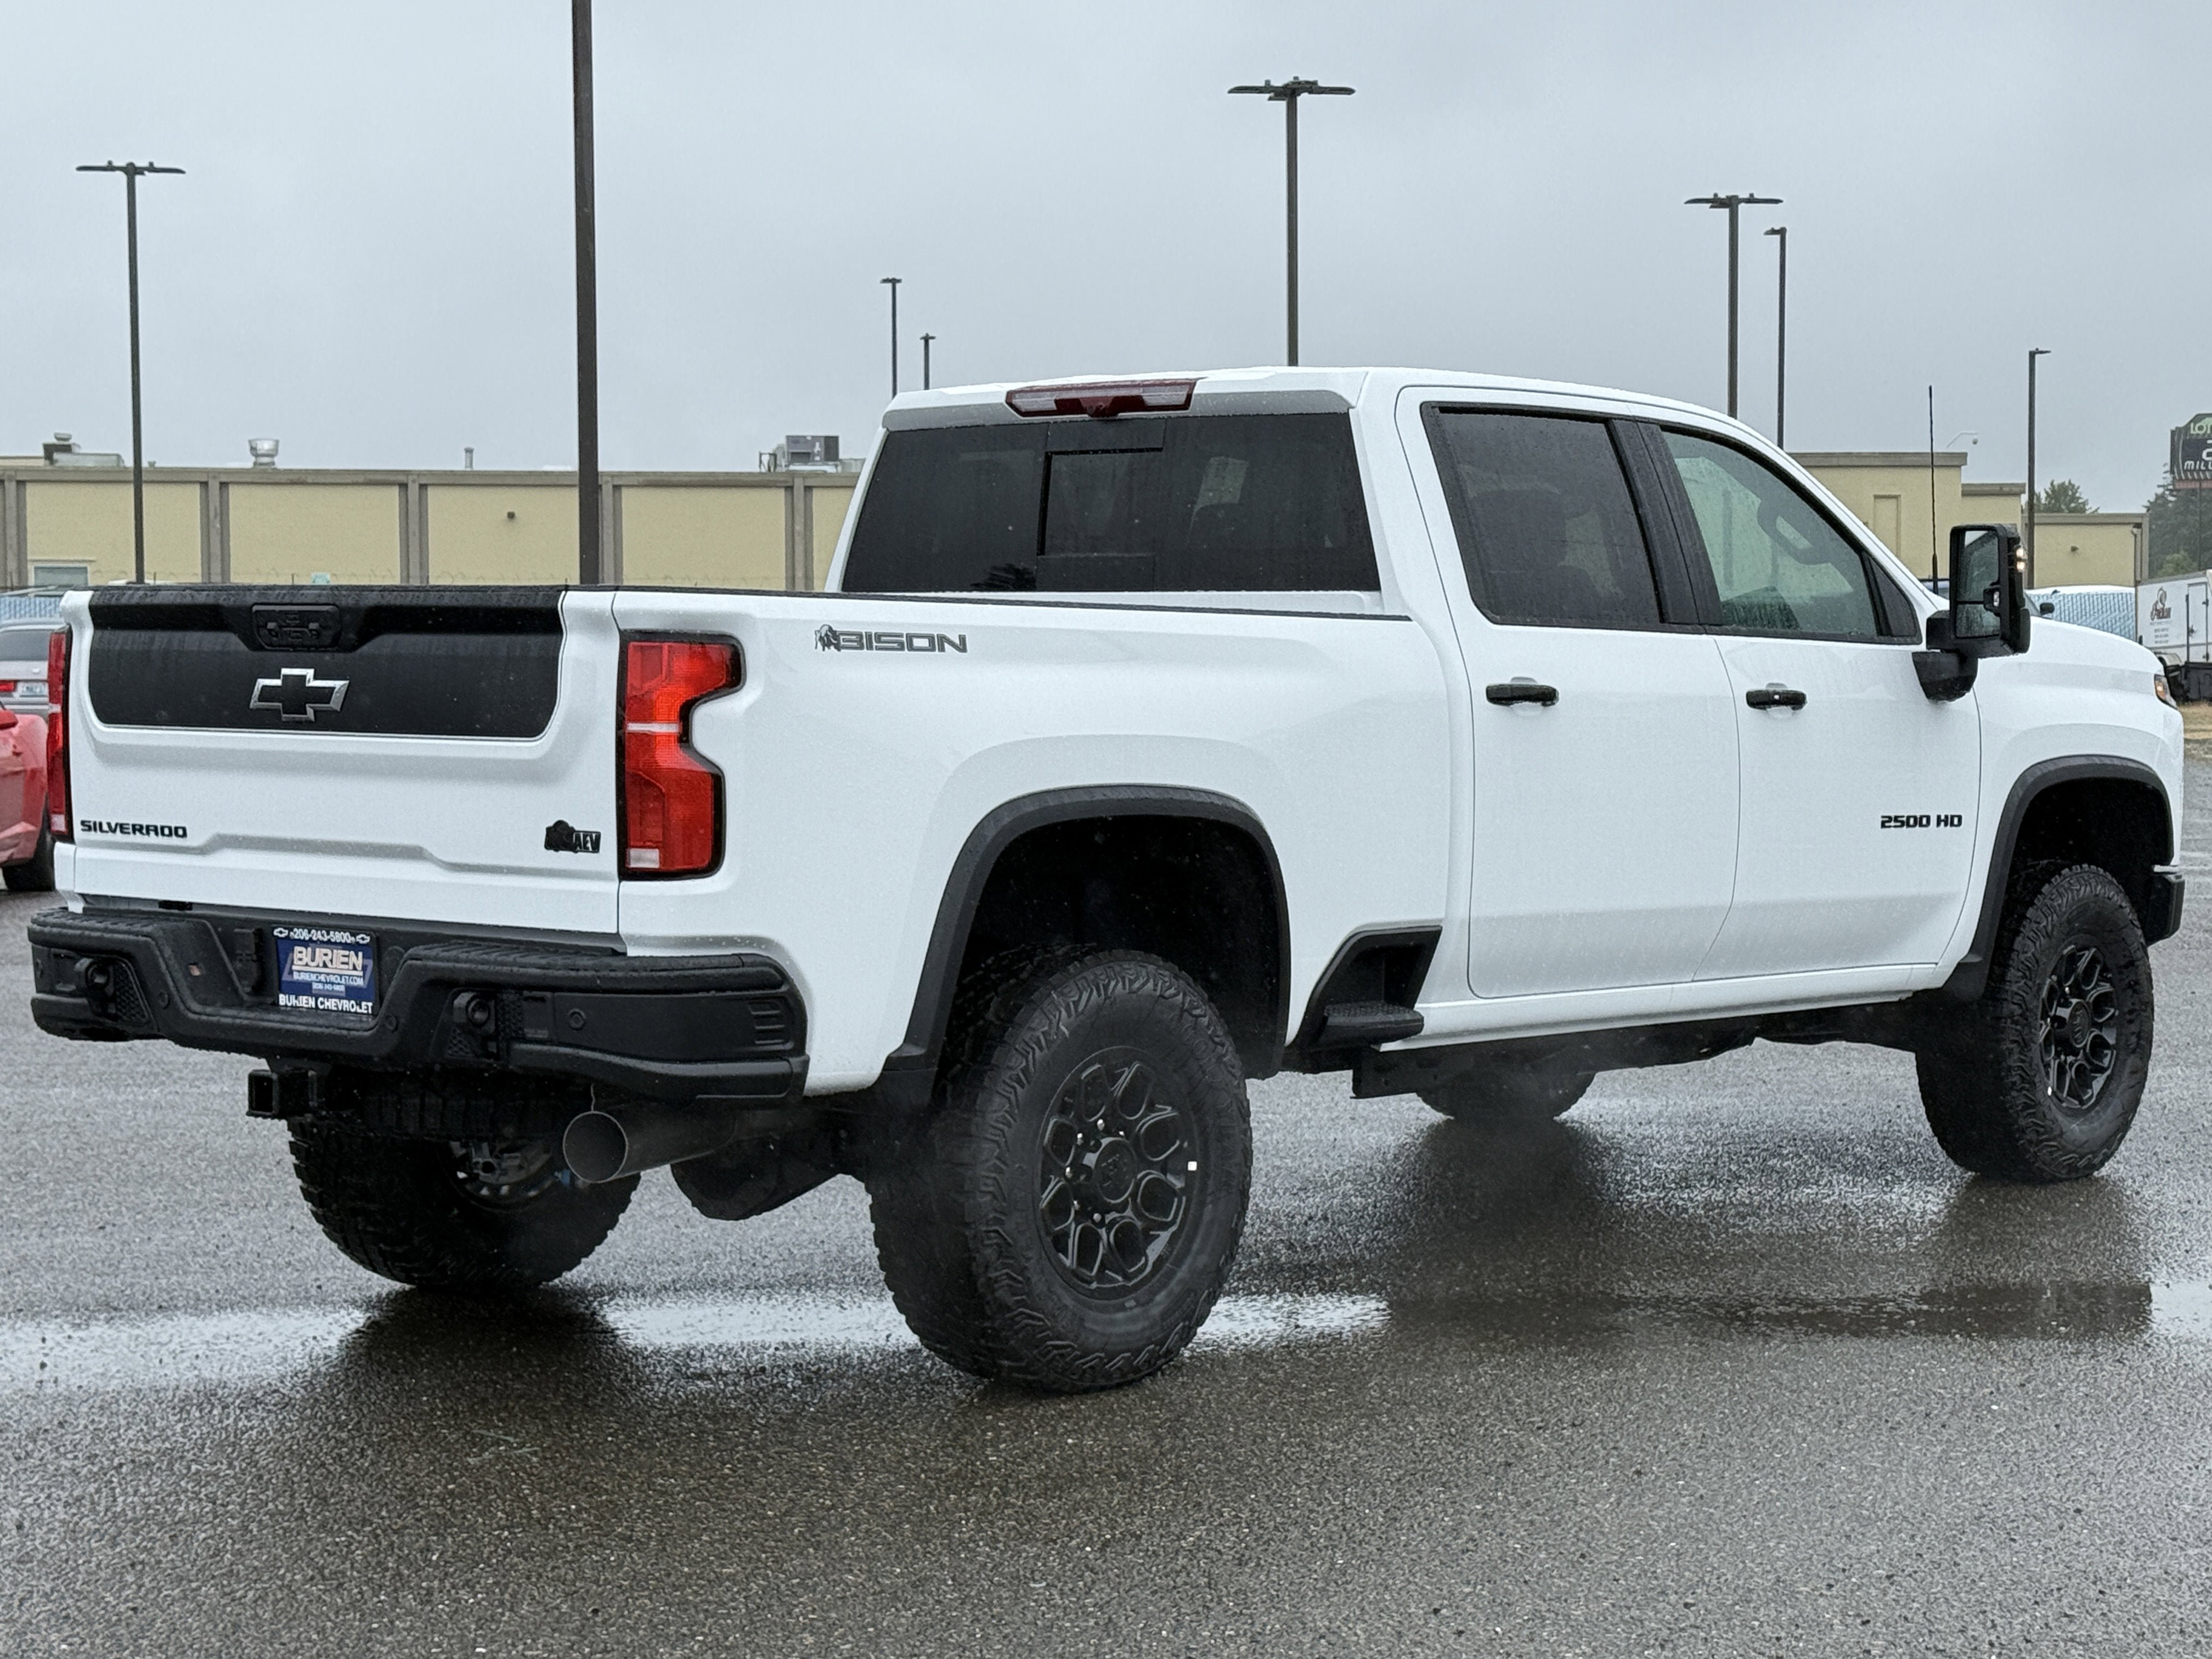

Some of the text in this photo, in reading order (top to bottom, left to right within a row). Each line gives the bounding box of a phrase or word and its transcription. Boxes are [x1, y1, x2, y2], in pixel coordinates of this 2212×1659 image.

[837, 631, 968, 653] BISON
[80, 820, 188, 838] SILVERADO
[1881, 814, 1962, 829] 2500 HD
[573, 832, 599, 851] AEV
[293, 928, 351, 943] 206-243-5800
[294, 946, 363, 971] BURIEN
[293, 972, 364, 986] BURIENCHEVROLET.COM
[279, 994, 374, 1014] BURIEN CHEVROLET
